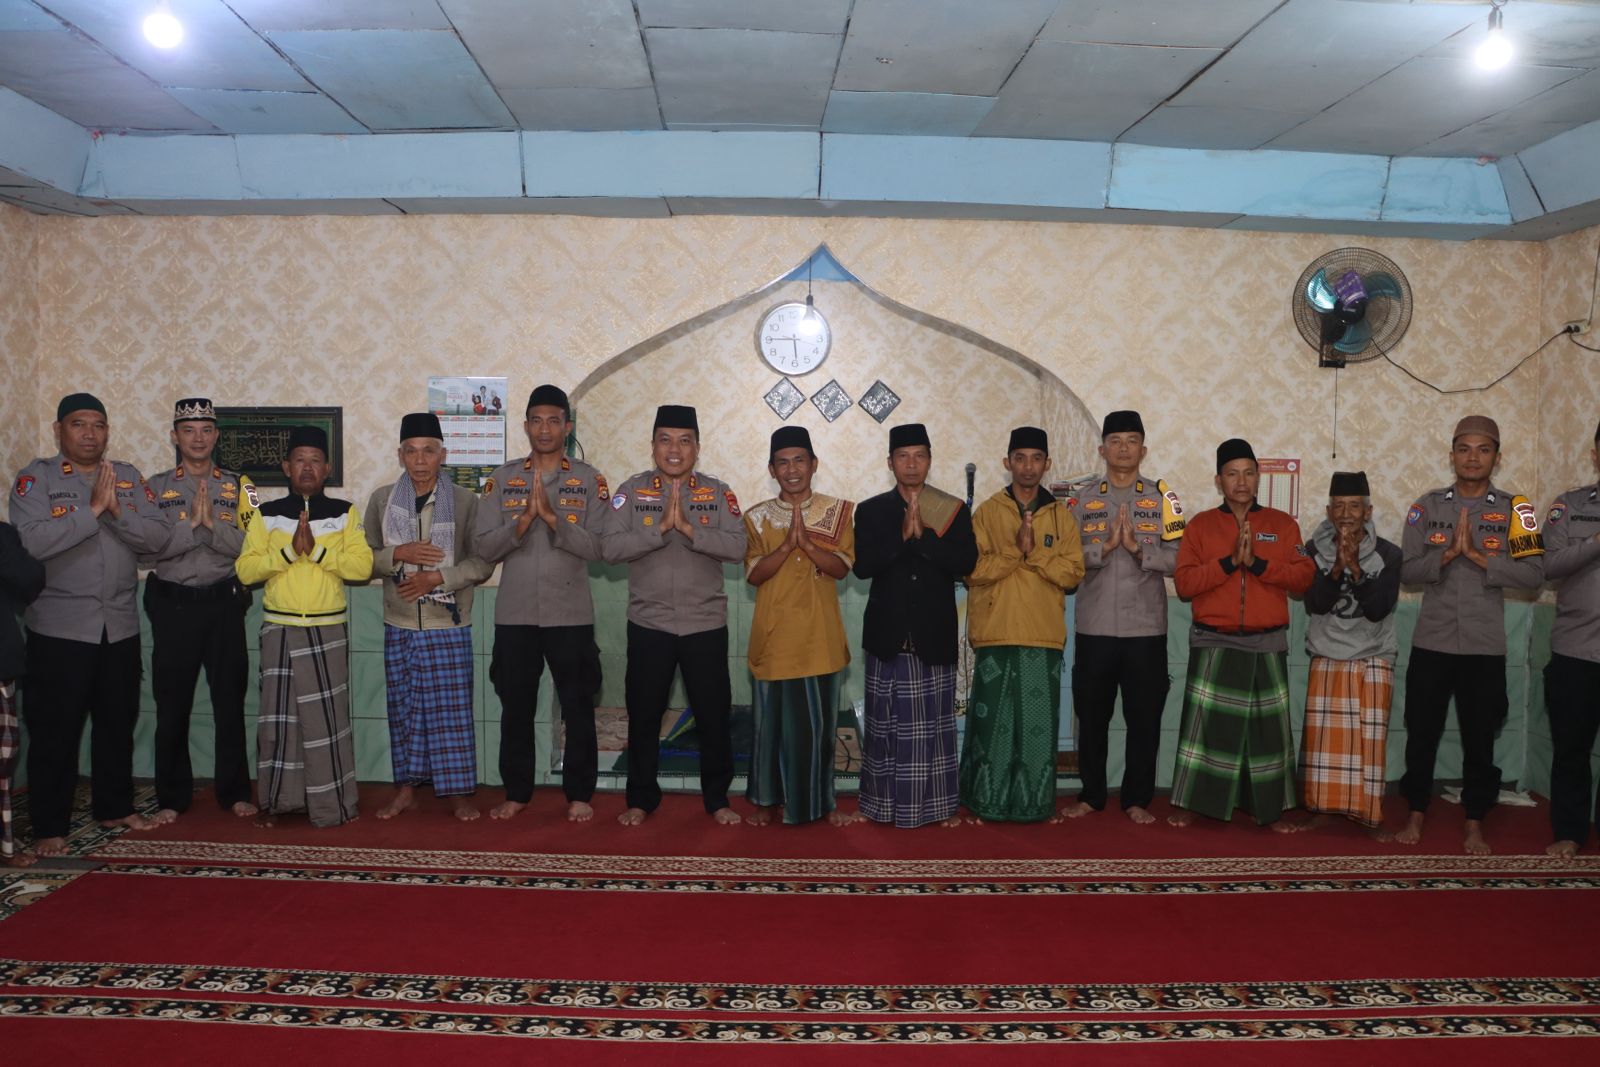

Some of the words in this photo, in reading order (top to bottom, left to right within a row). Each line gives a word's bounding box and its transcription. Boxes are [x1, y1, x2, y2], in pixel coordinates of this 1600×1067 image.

[770, 348, 777, 356] 8
[779, 356, 786, 365] 7
[791, 359, 799, 368] 6
[803, 356, 811, 364] 5
[559, 487, 587, 495] POLRI
[634, 504, 663, 513] YURIKO
[689, 504, 718, 512] POLRI
[1082, 511, 1108, 521] UNTORO
[1428, 521, 1453, 530] IRSA
